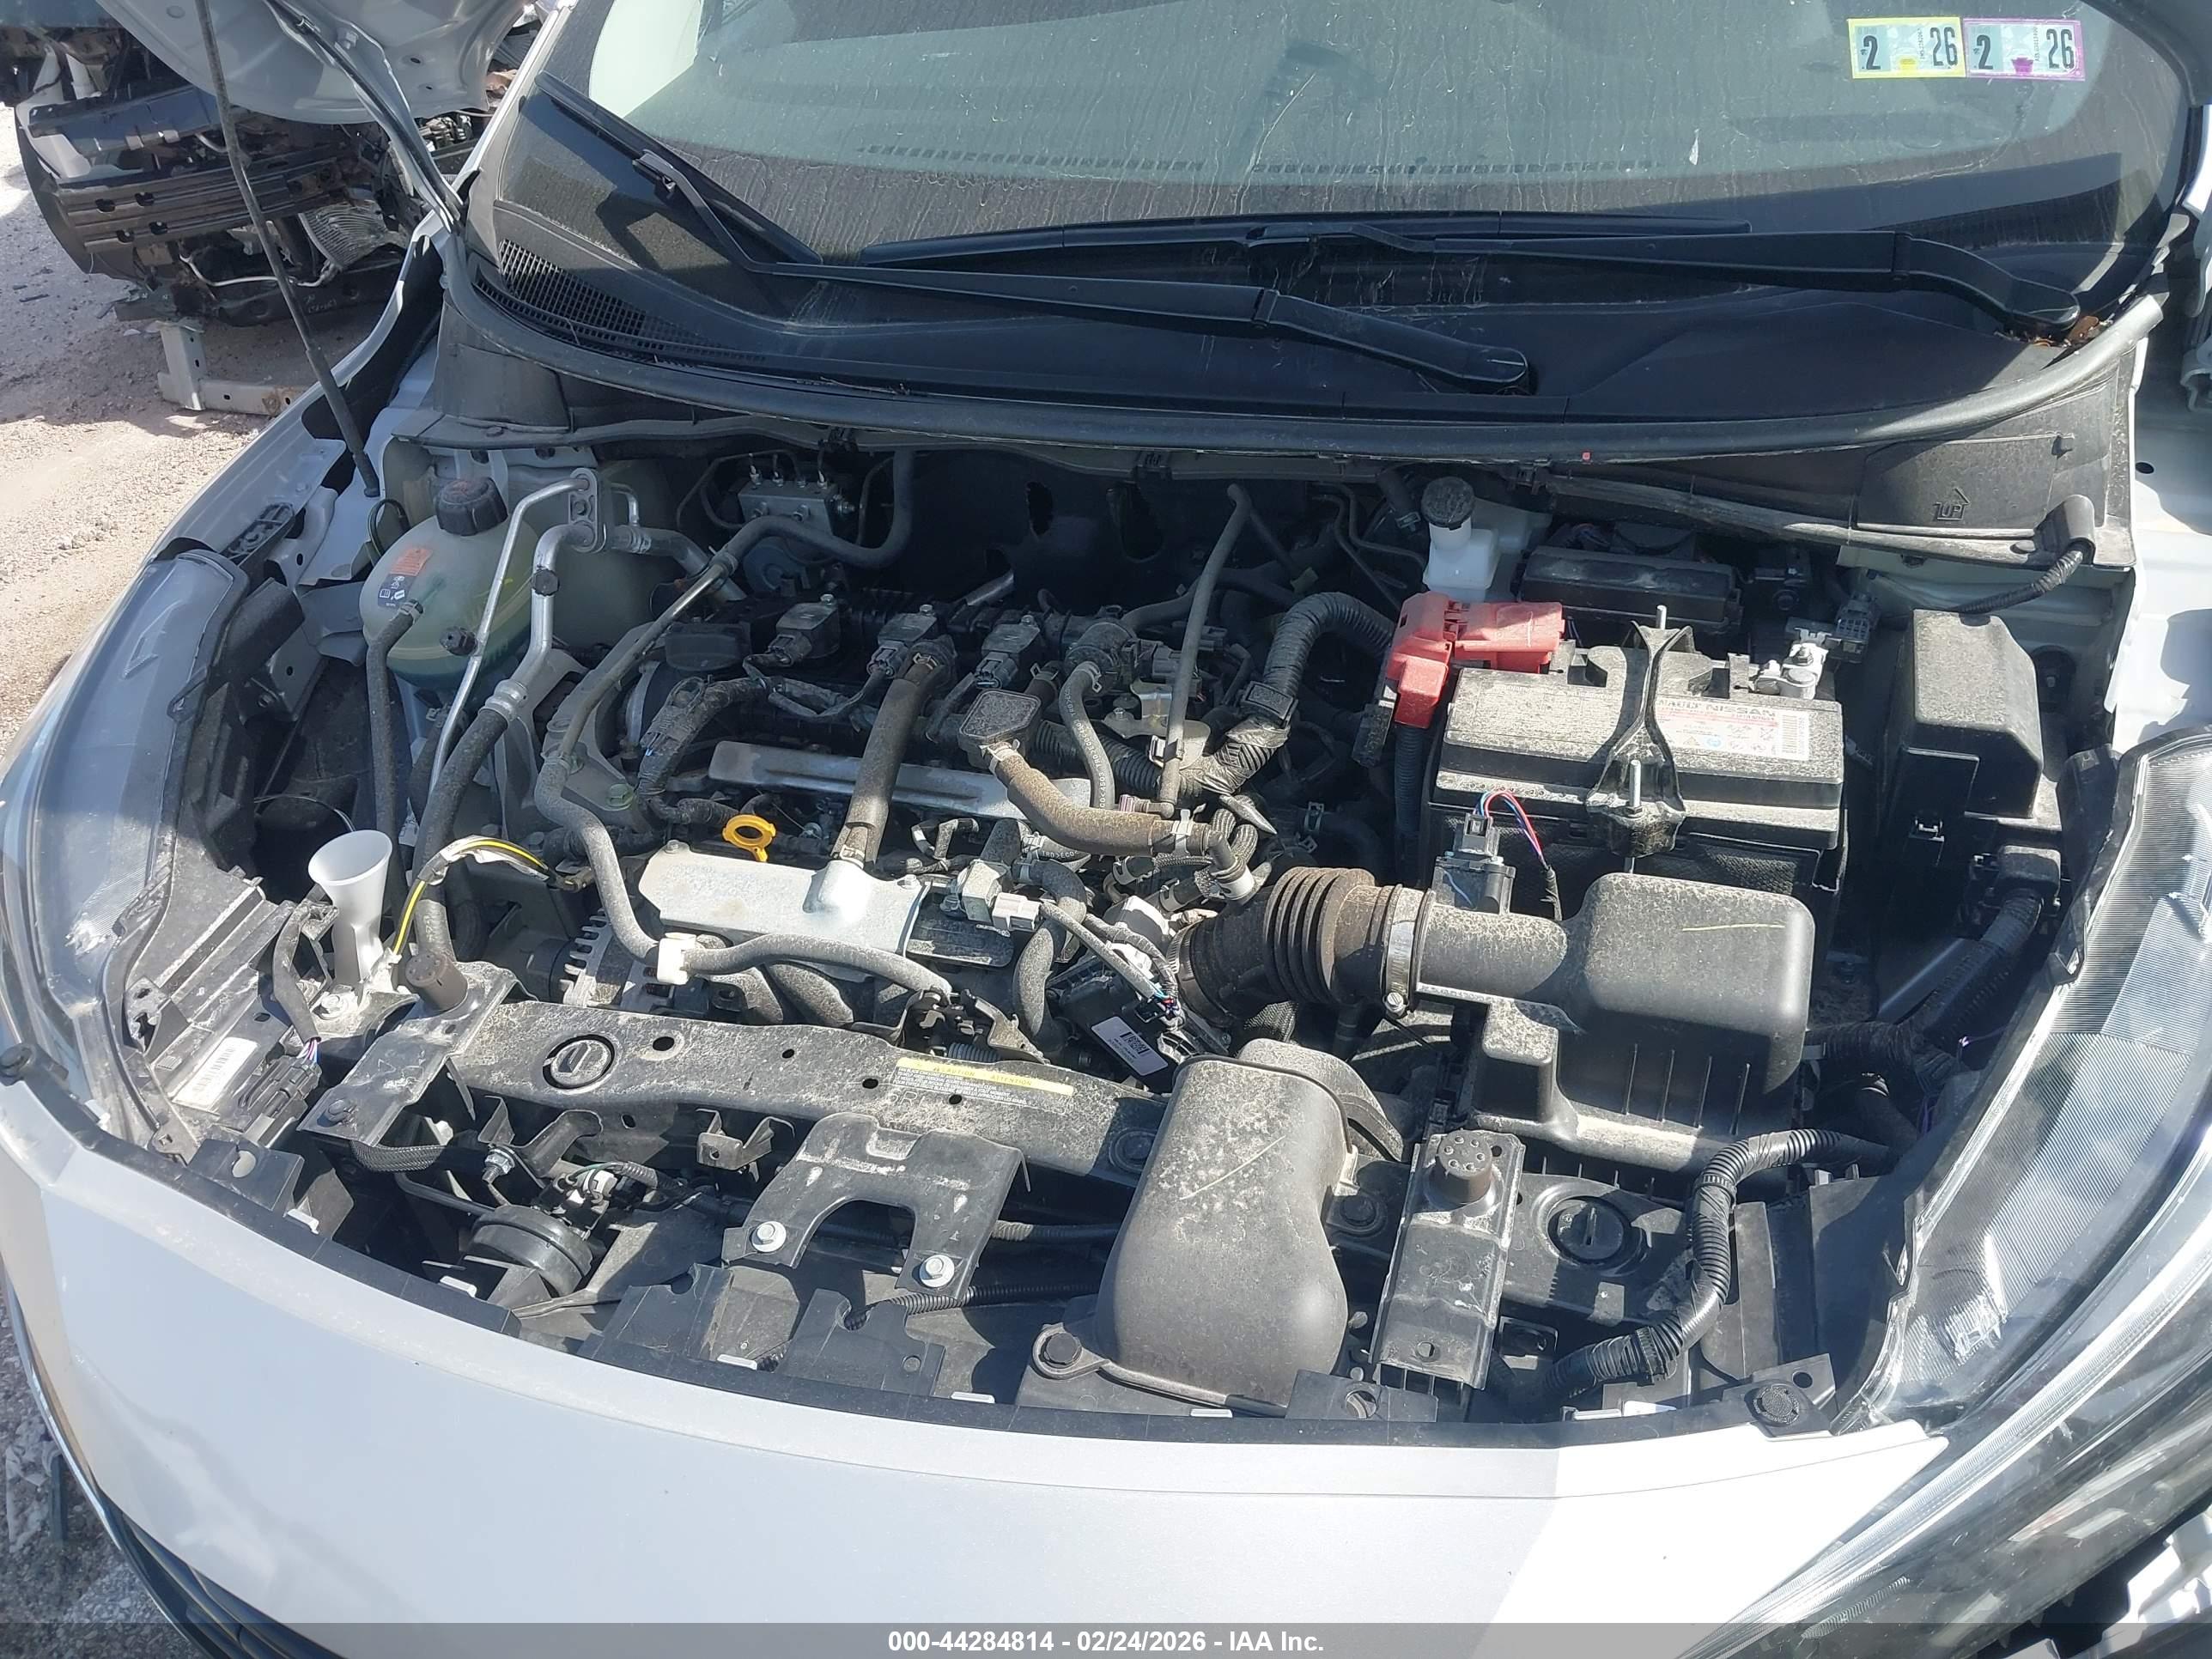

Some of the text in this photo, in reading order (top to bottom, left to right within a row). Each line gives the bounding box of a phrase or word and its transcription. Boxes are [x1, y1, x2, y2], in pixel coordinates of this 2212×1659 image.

[1863, 34, 1881, 70] 2
[1929, 27, 1959, 67] 26
[1976, 34, 1994, 70] 2
[2045, 28, 2075, 70] 26
[1705, 703, 1776, 718] NISSAN
